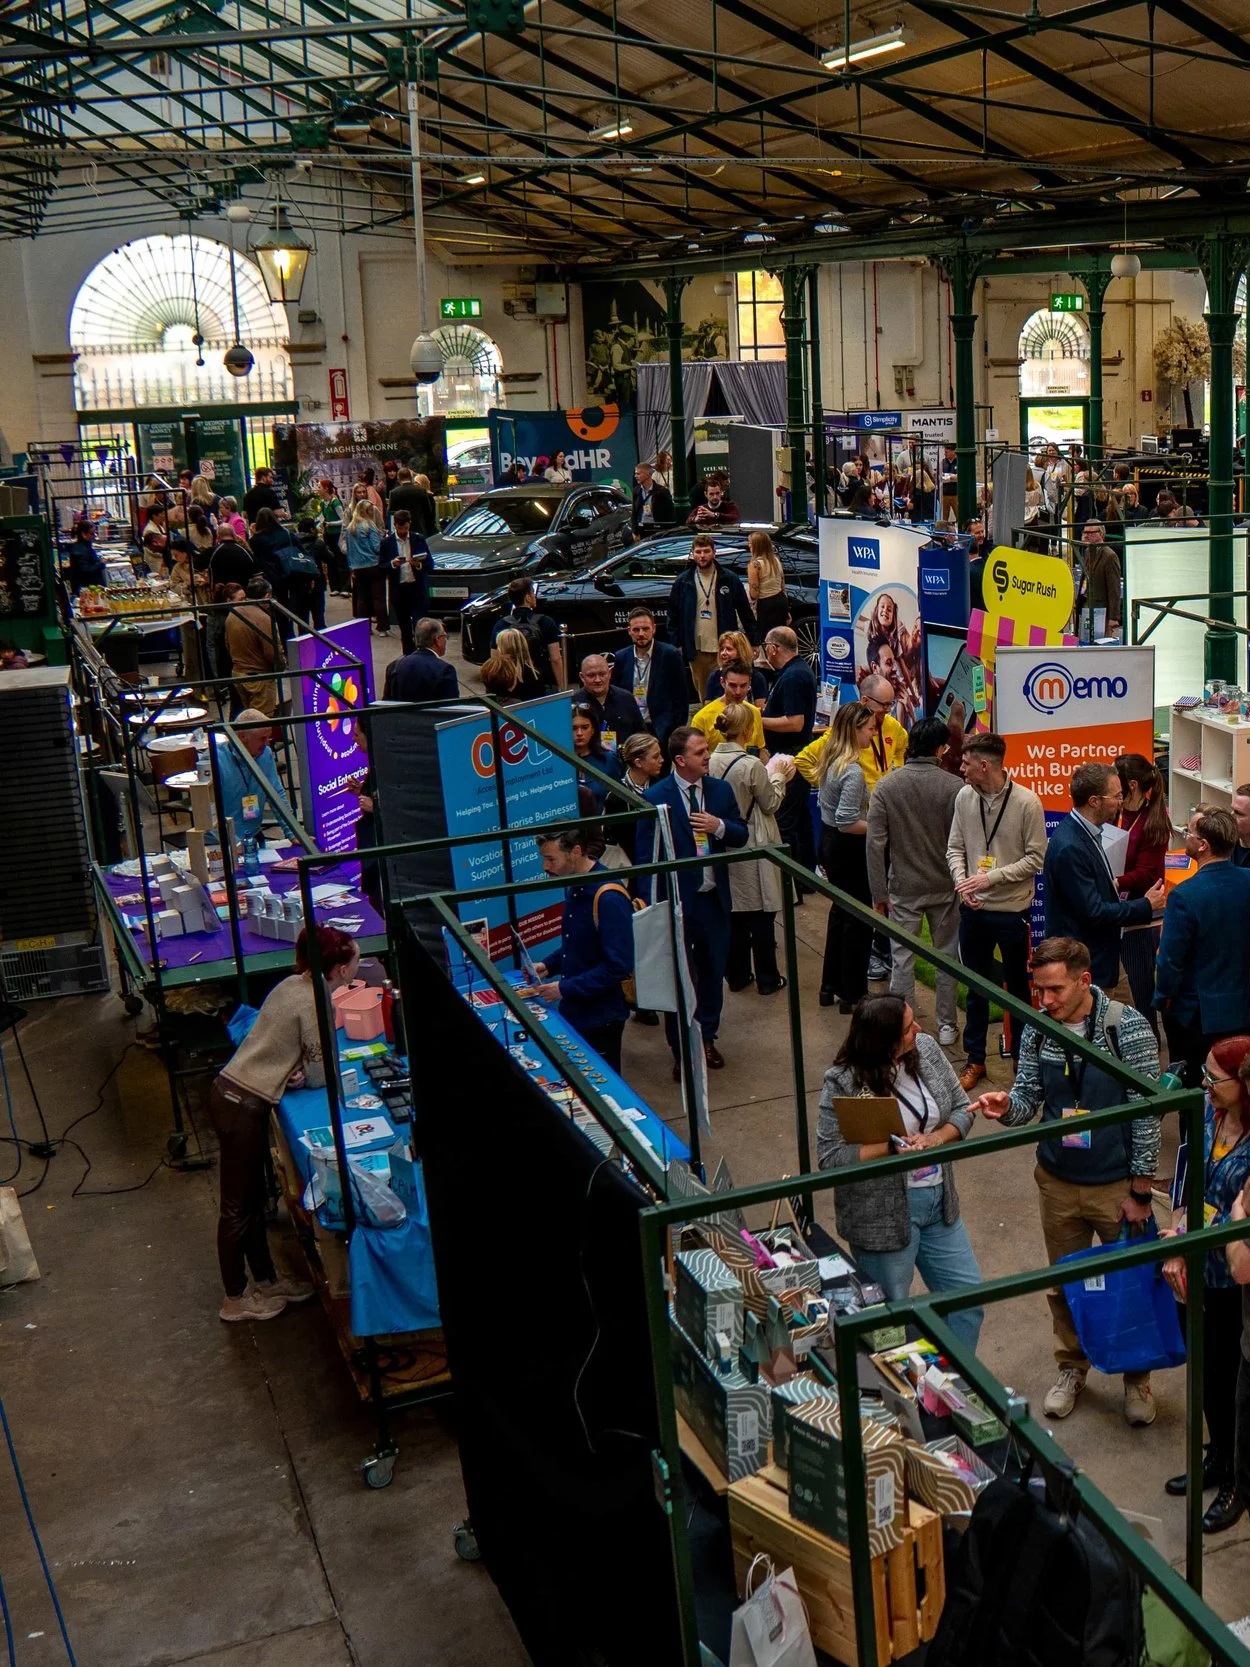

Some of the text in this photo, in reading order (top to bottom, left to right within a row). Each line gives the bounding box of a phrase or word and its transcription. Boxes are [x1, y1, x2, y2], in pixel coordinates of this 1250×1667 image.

[872, 416, 897, 424] Simplicity
[911, 418, 953, 427] MANTIS
[325, 443, 399, 454] MAGHERAMORNE
[852, 546, 877, 561] WPA
[924, 575, 946, 585] WPA
[1011, 575, 1058, 599] Sugar Rush
[1027, 743, 1126, 759] We Partner
[1005, 761, 1045, 778] with
[318, 765, 369, 796] Social Enterprise
[476, 766, 553, 795] Acces mployment Ltd
[1031, 780, 1064, 796] like
[456, 777, 574, 817] Helping You. Us. Helping Others.
[535, 802, 577, 822] Businesses
[470, 852, 539, 882] Support ervices
[528, 913, 545, 924] MISSION
